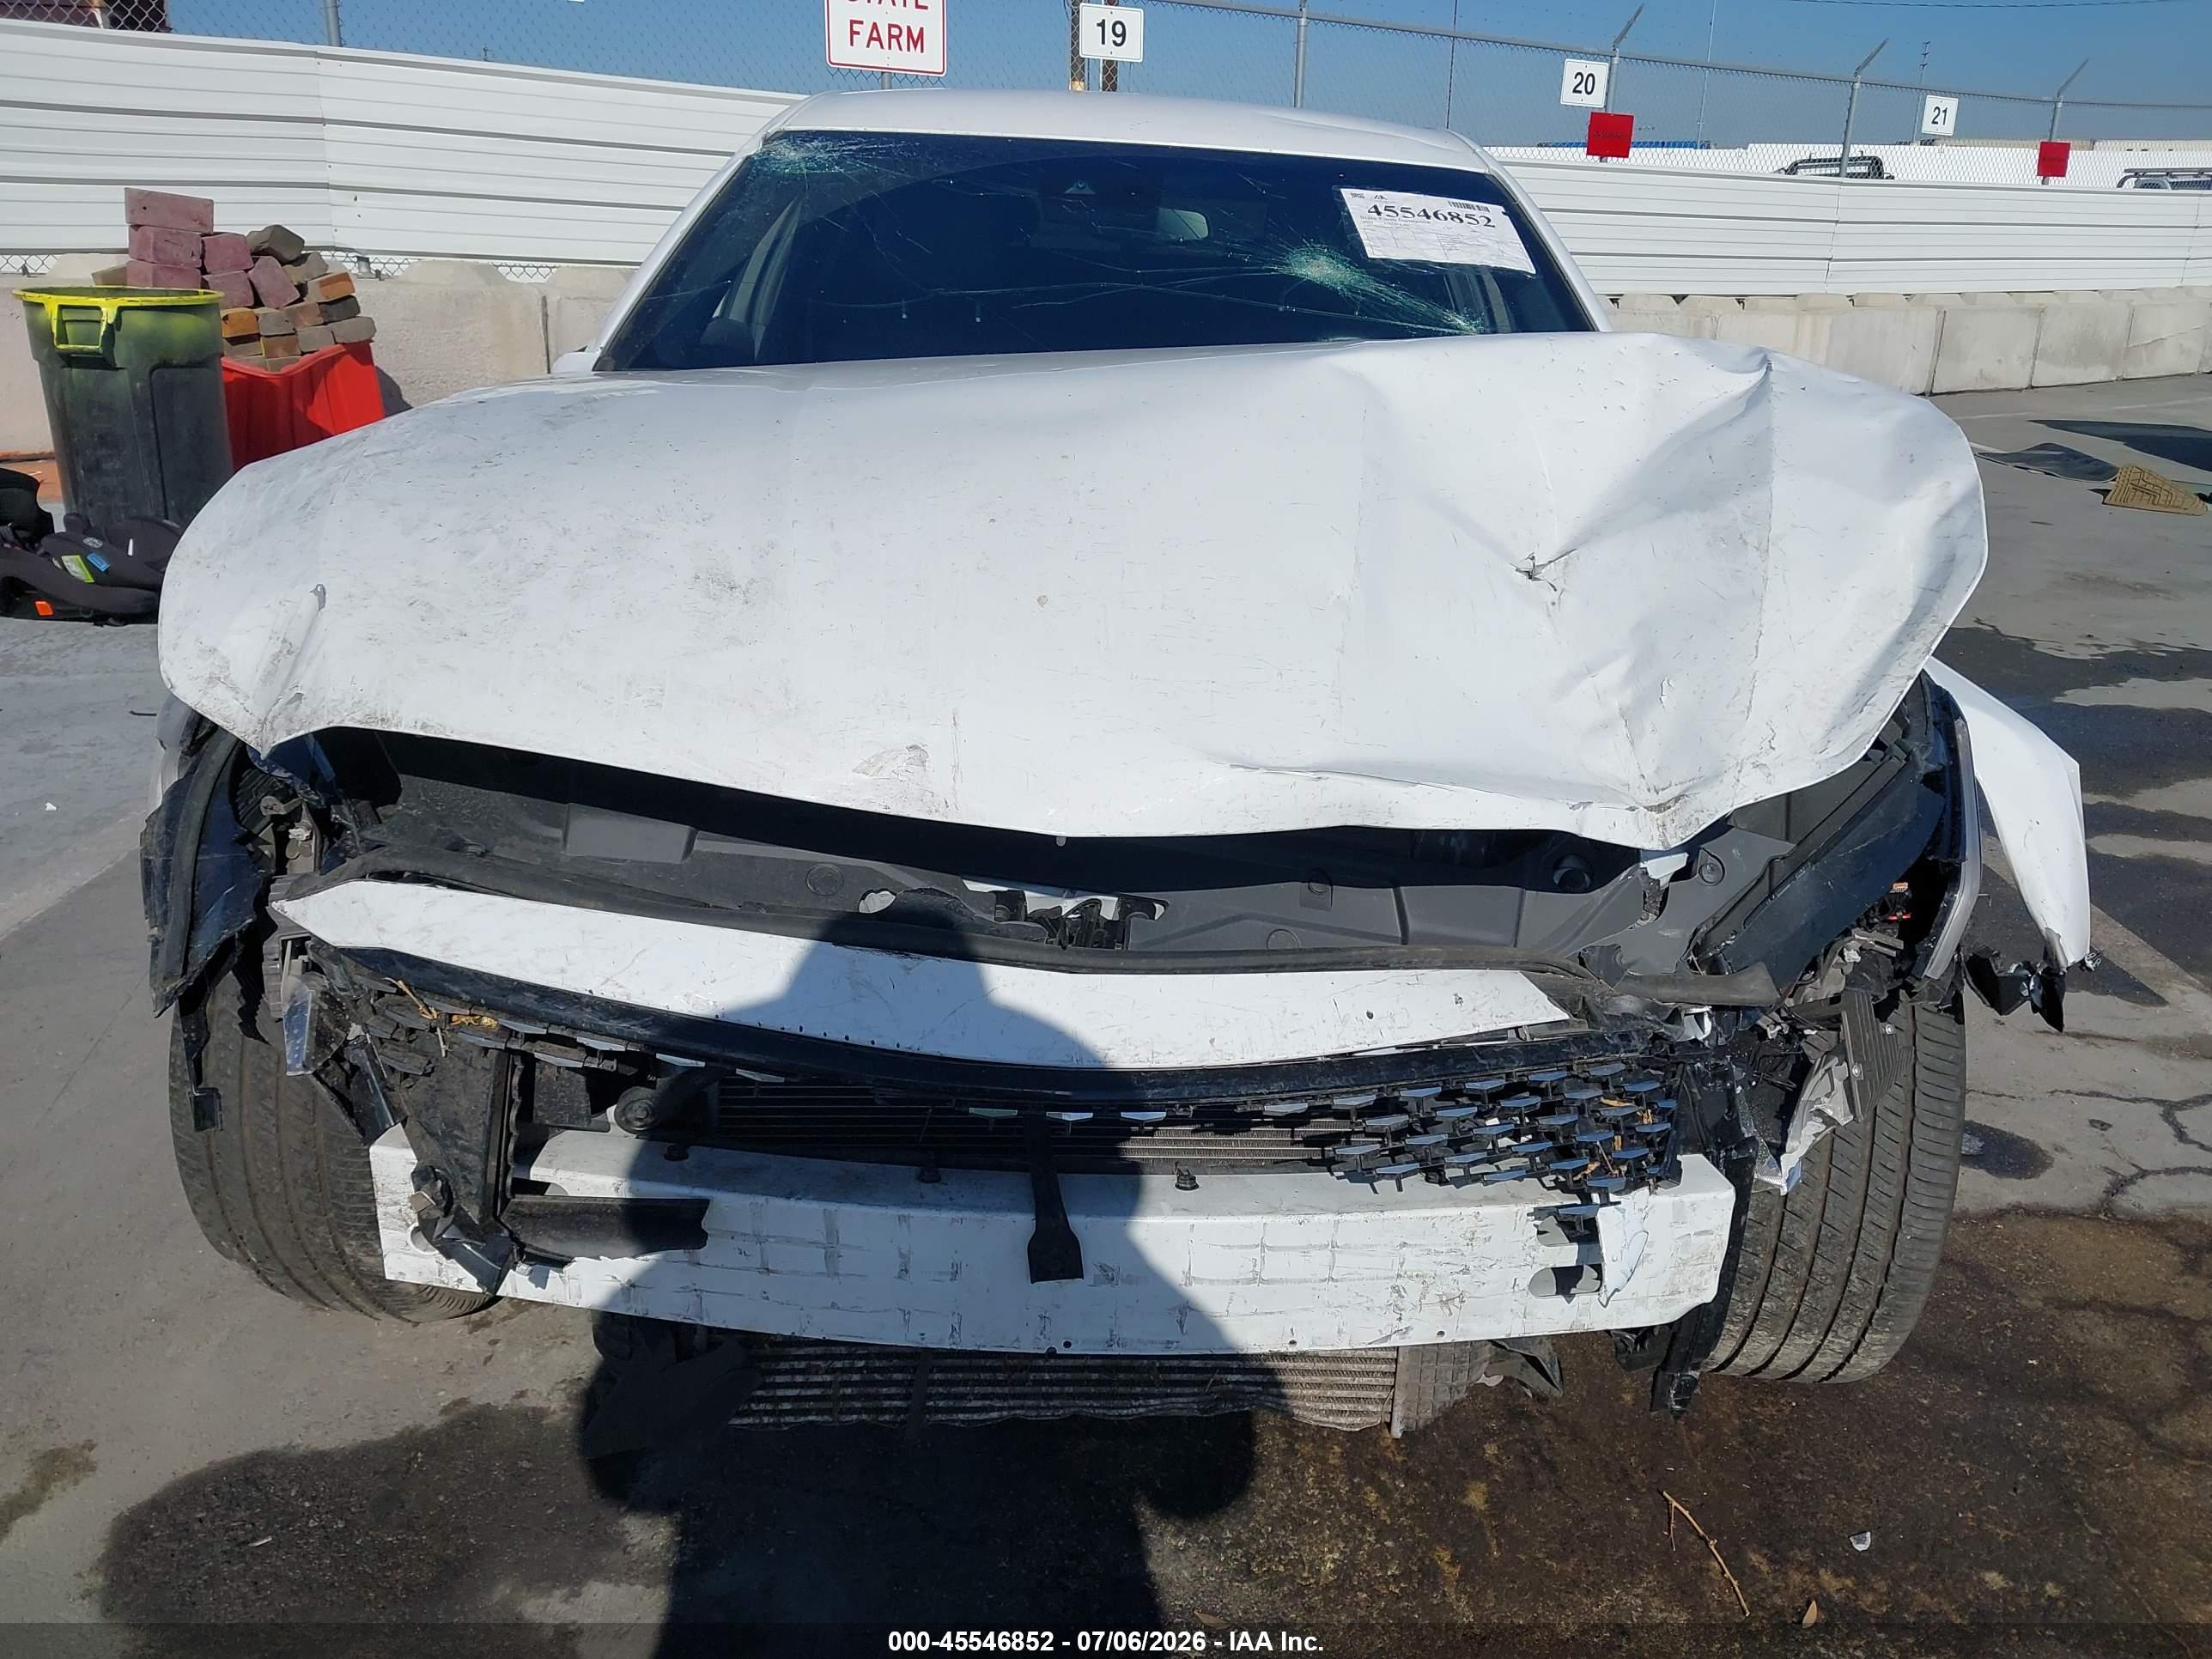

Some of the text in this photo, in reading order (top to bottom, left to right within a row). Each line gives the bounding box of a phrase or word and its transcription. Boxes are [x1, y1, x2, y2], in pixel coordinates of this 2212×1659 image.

[849, 19, 924, 53] FARM
[1097, 19, 1127, 47] 19
[1572, 71, 1595, 95] 20
[1931, 106, 1948, 125] 21
[1367, 204, 1496, 228] 45546852
